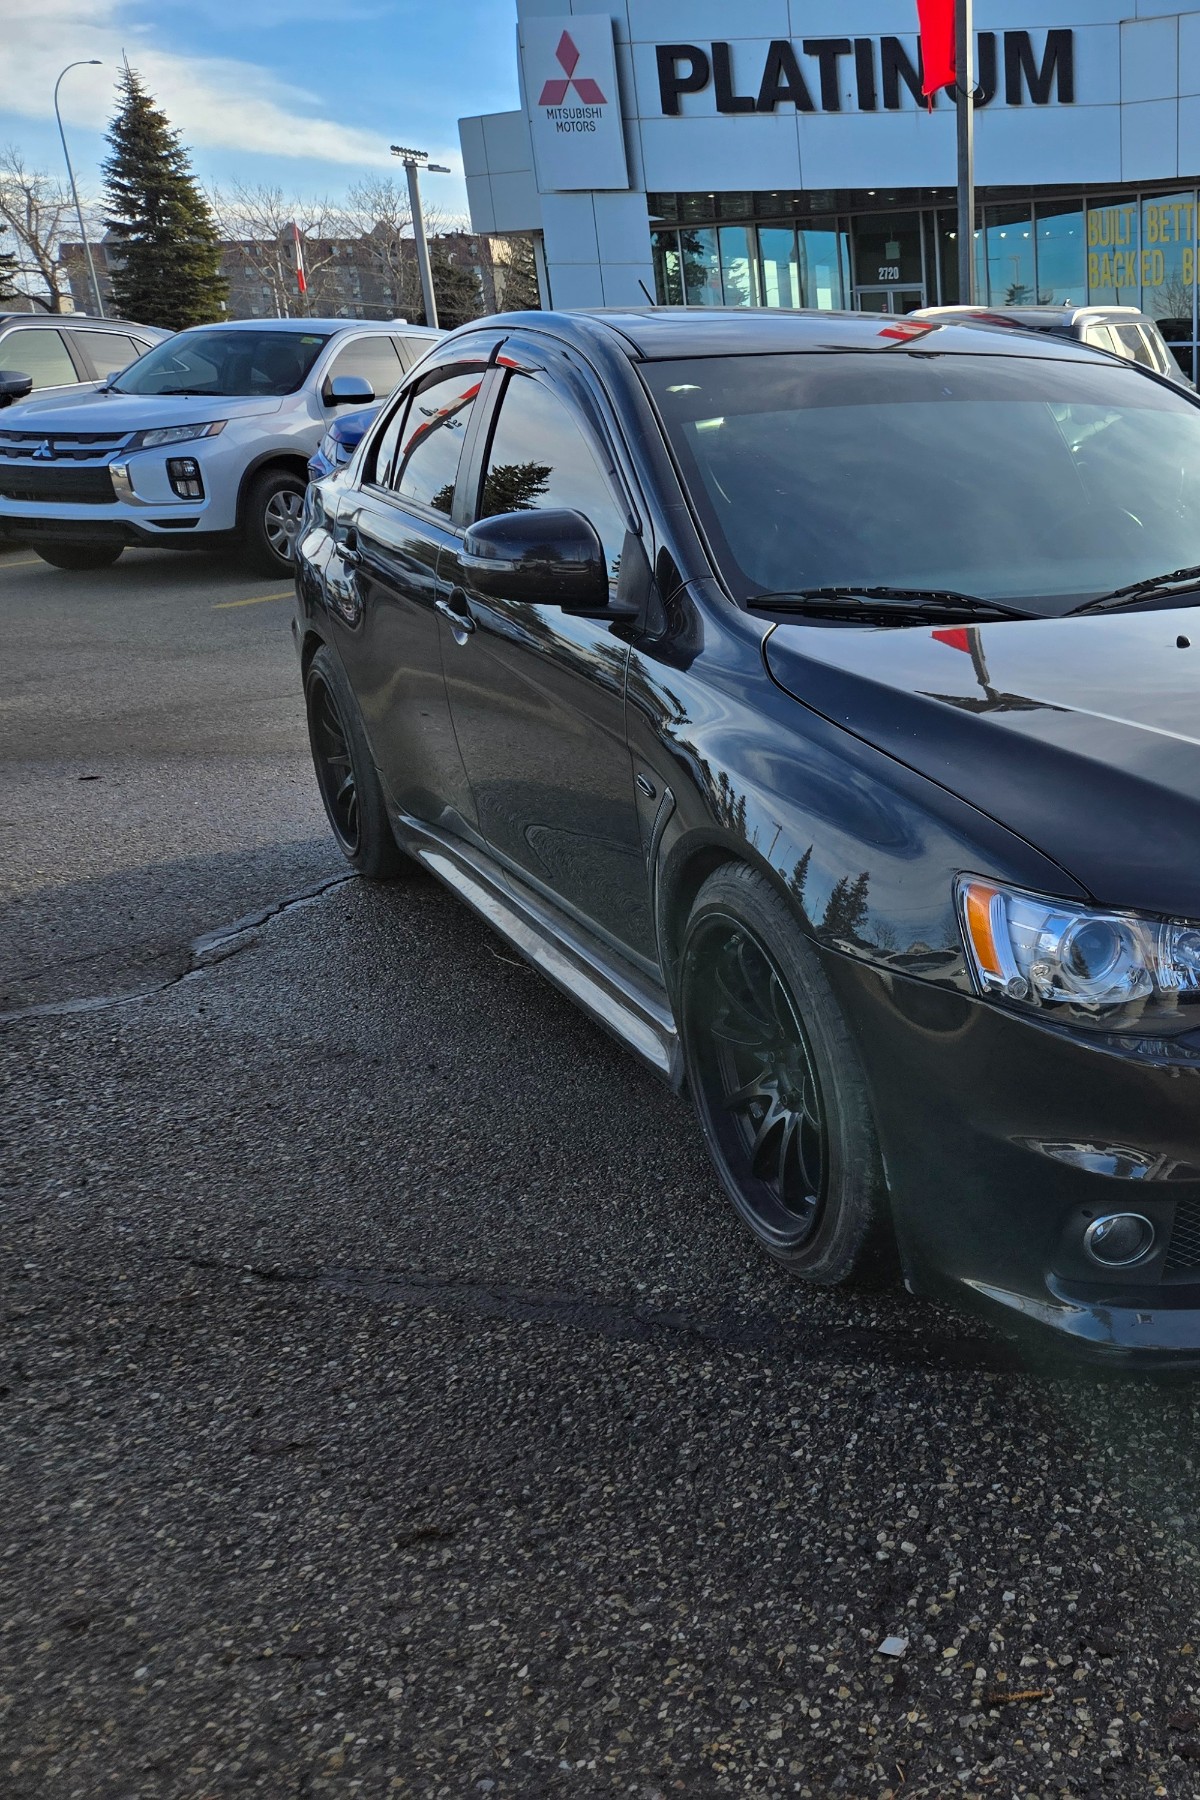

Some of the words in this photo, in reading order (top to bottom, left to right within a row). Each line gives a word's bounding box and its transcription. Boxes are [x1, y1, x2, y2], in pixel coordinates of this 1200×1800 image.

[546, 107, 602, 120] MITSUBISHI
[556, 121, 596, 133] MOTORS
[1087, 207, 1134, 247] BUILT
[878, 266, 900, 280] 2720
[1088, 249, 1166, 289] BACKED
